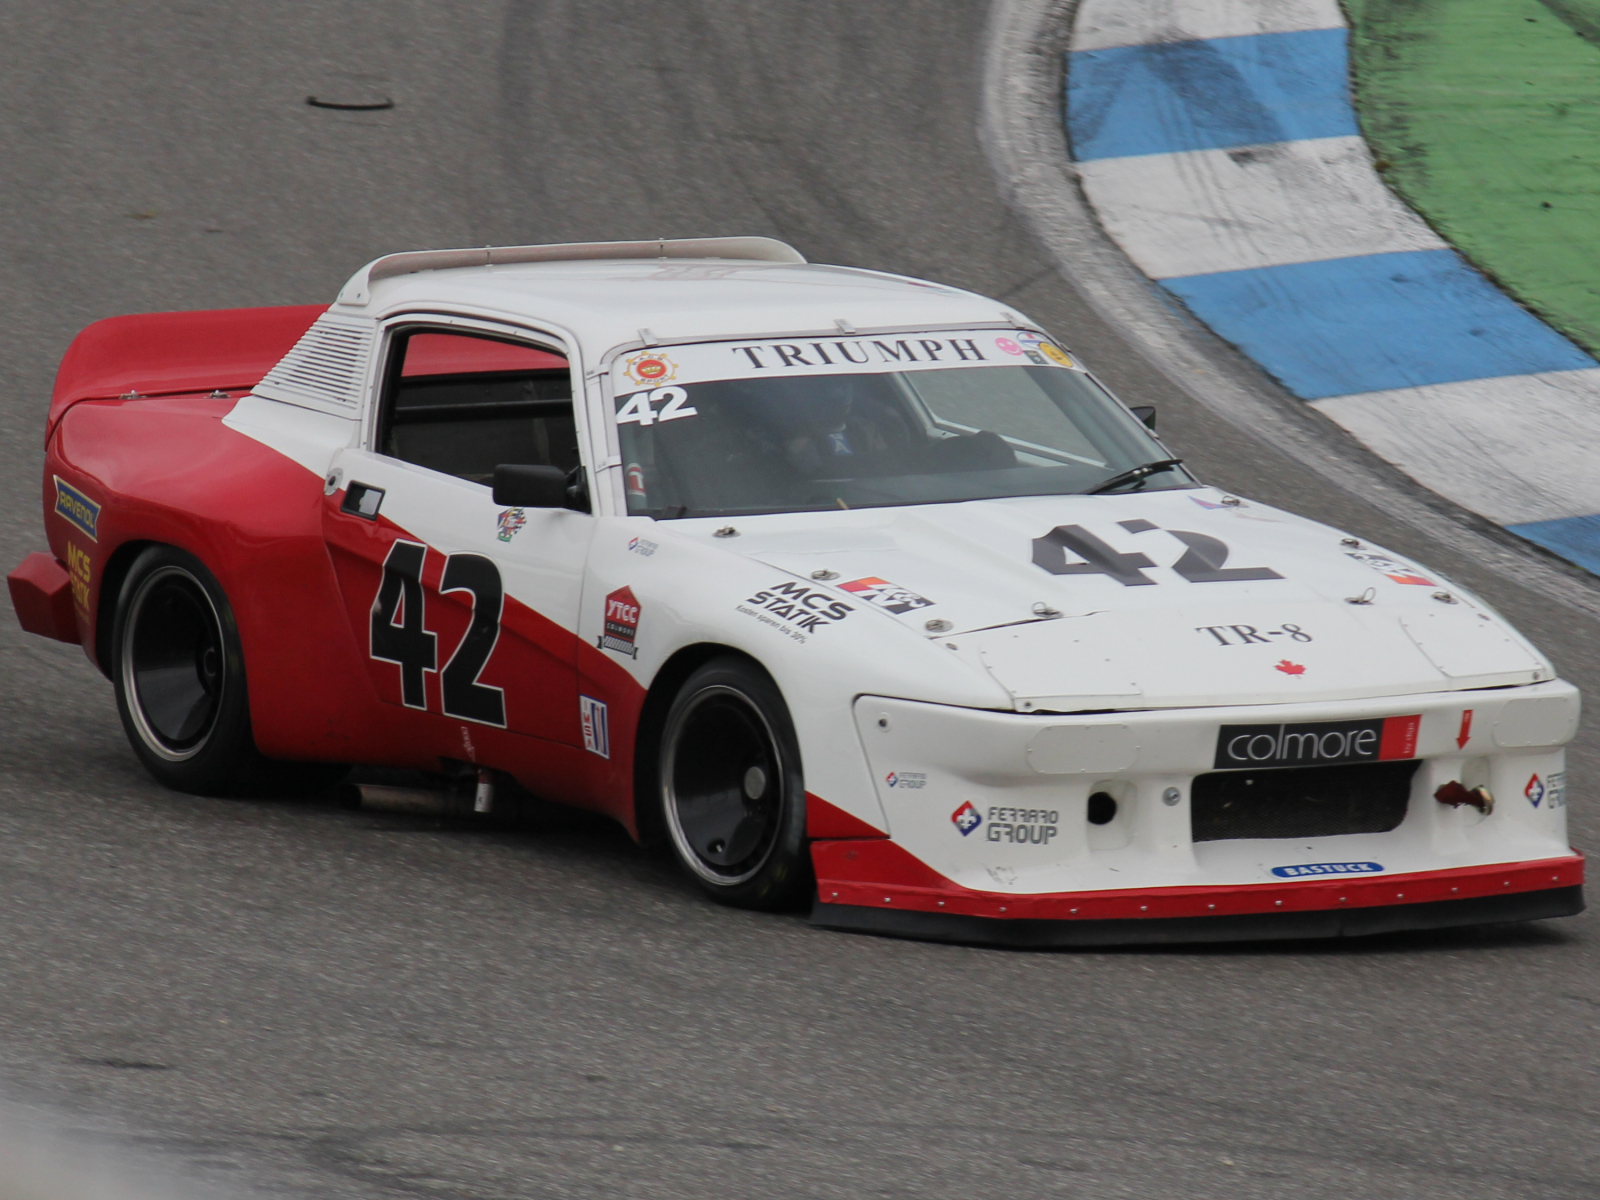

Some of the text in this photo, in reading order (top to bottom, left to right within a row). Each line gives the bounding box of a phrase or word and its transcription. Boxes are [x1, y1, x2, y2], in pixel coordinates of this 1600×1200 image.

[731, 338, 989, 369] TRIUMPH
[616, 386, 698, 426] 42
[60, 491, 95, 529] RAVENOL
[67, 540, 91, 583] MCS
[1032, 518, 1287, 586] 42
[607, 599, 638, 624] YTCC
[746, 591, 831, 634] STATIK
[770, 582, 856, 621] MCS
[370, 538, 507, 729] 42
[779, 625, 792, 635] bis
[1195, 623, 1313, 646] TR-8
[1227, 724, 1376, 760] colmore
[987, 822, 1058, 845] GROUP
[988, 806, 1059, 825] FERRARO
[1283, 862, 1371, 876] BASTUCK
